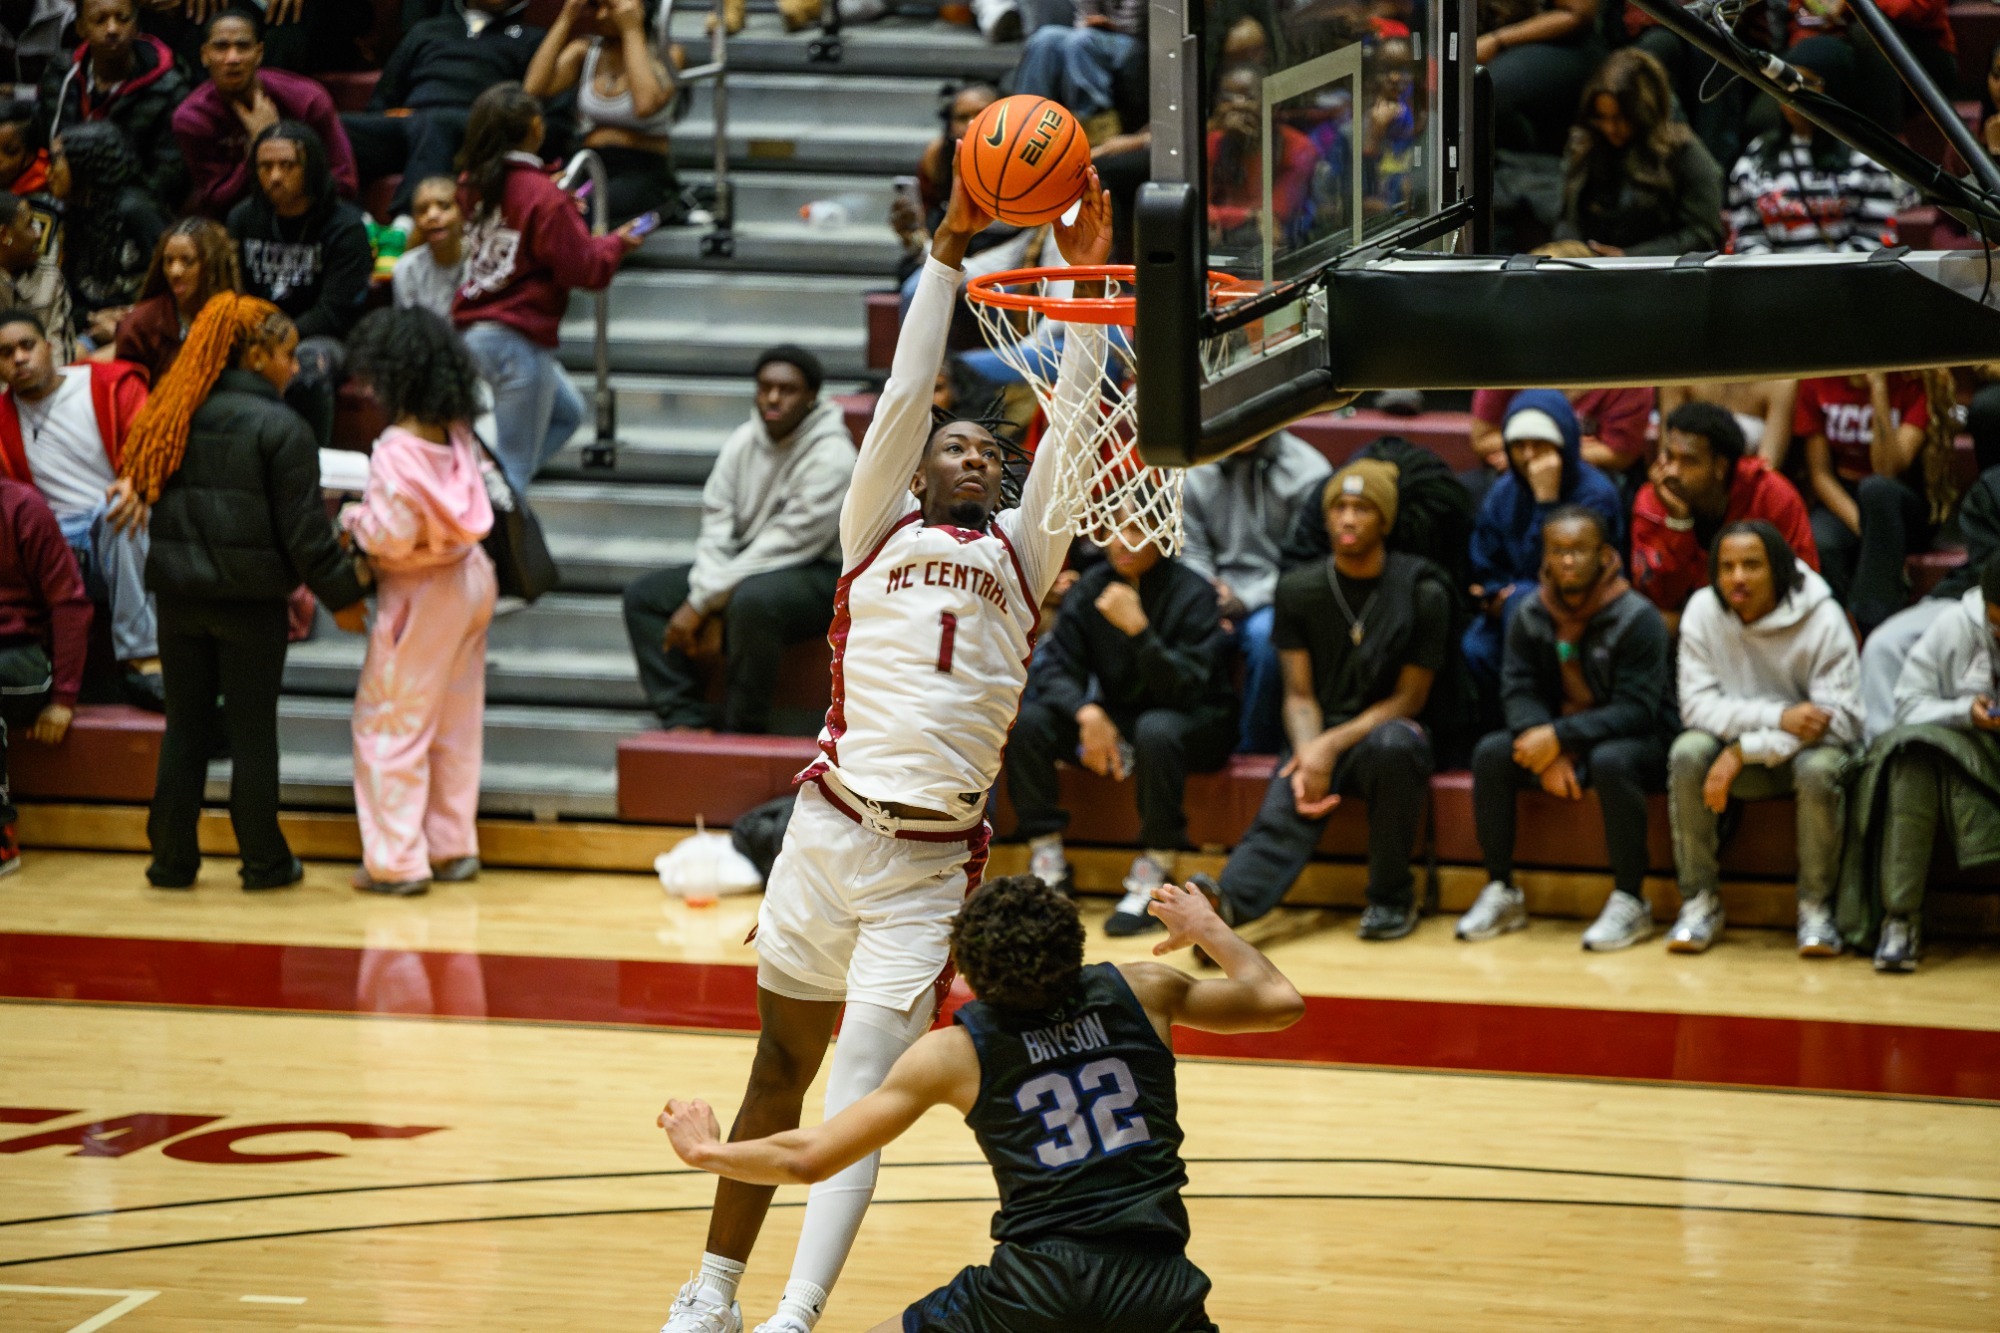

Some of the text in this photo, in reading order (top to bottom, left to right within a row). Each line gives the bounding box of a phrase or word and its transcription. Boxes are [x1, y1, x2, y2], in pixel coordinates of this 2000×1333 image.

[1019, 108, 1063, 167] ELITE
[886, 561, 1008, 615] NC CENTRAL
[935, 610, 959, 675] 1
[1020, 1012, 1110, 1065] BRYSON
[0, 1107, 453, 1164] AC
[1015, 1057, 1152, 1169] 32
